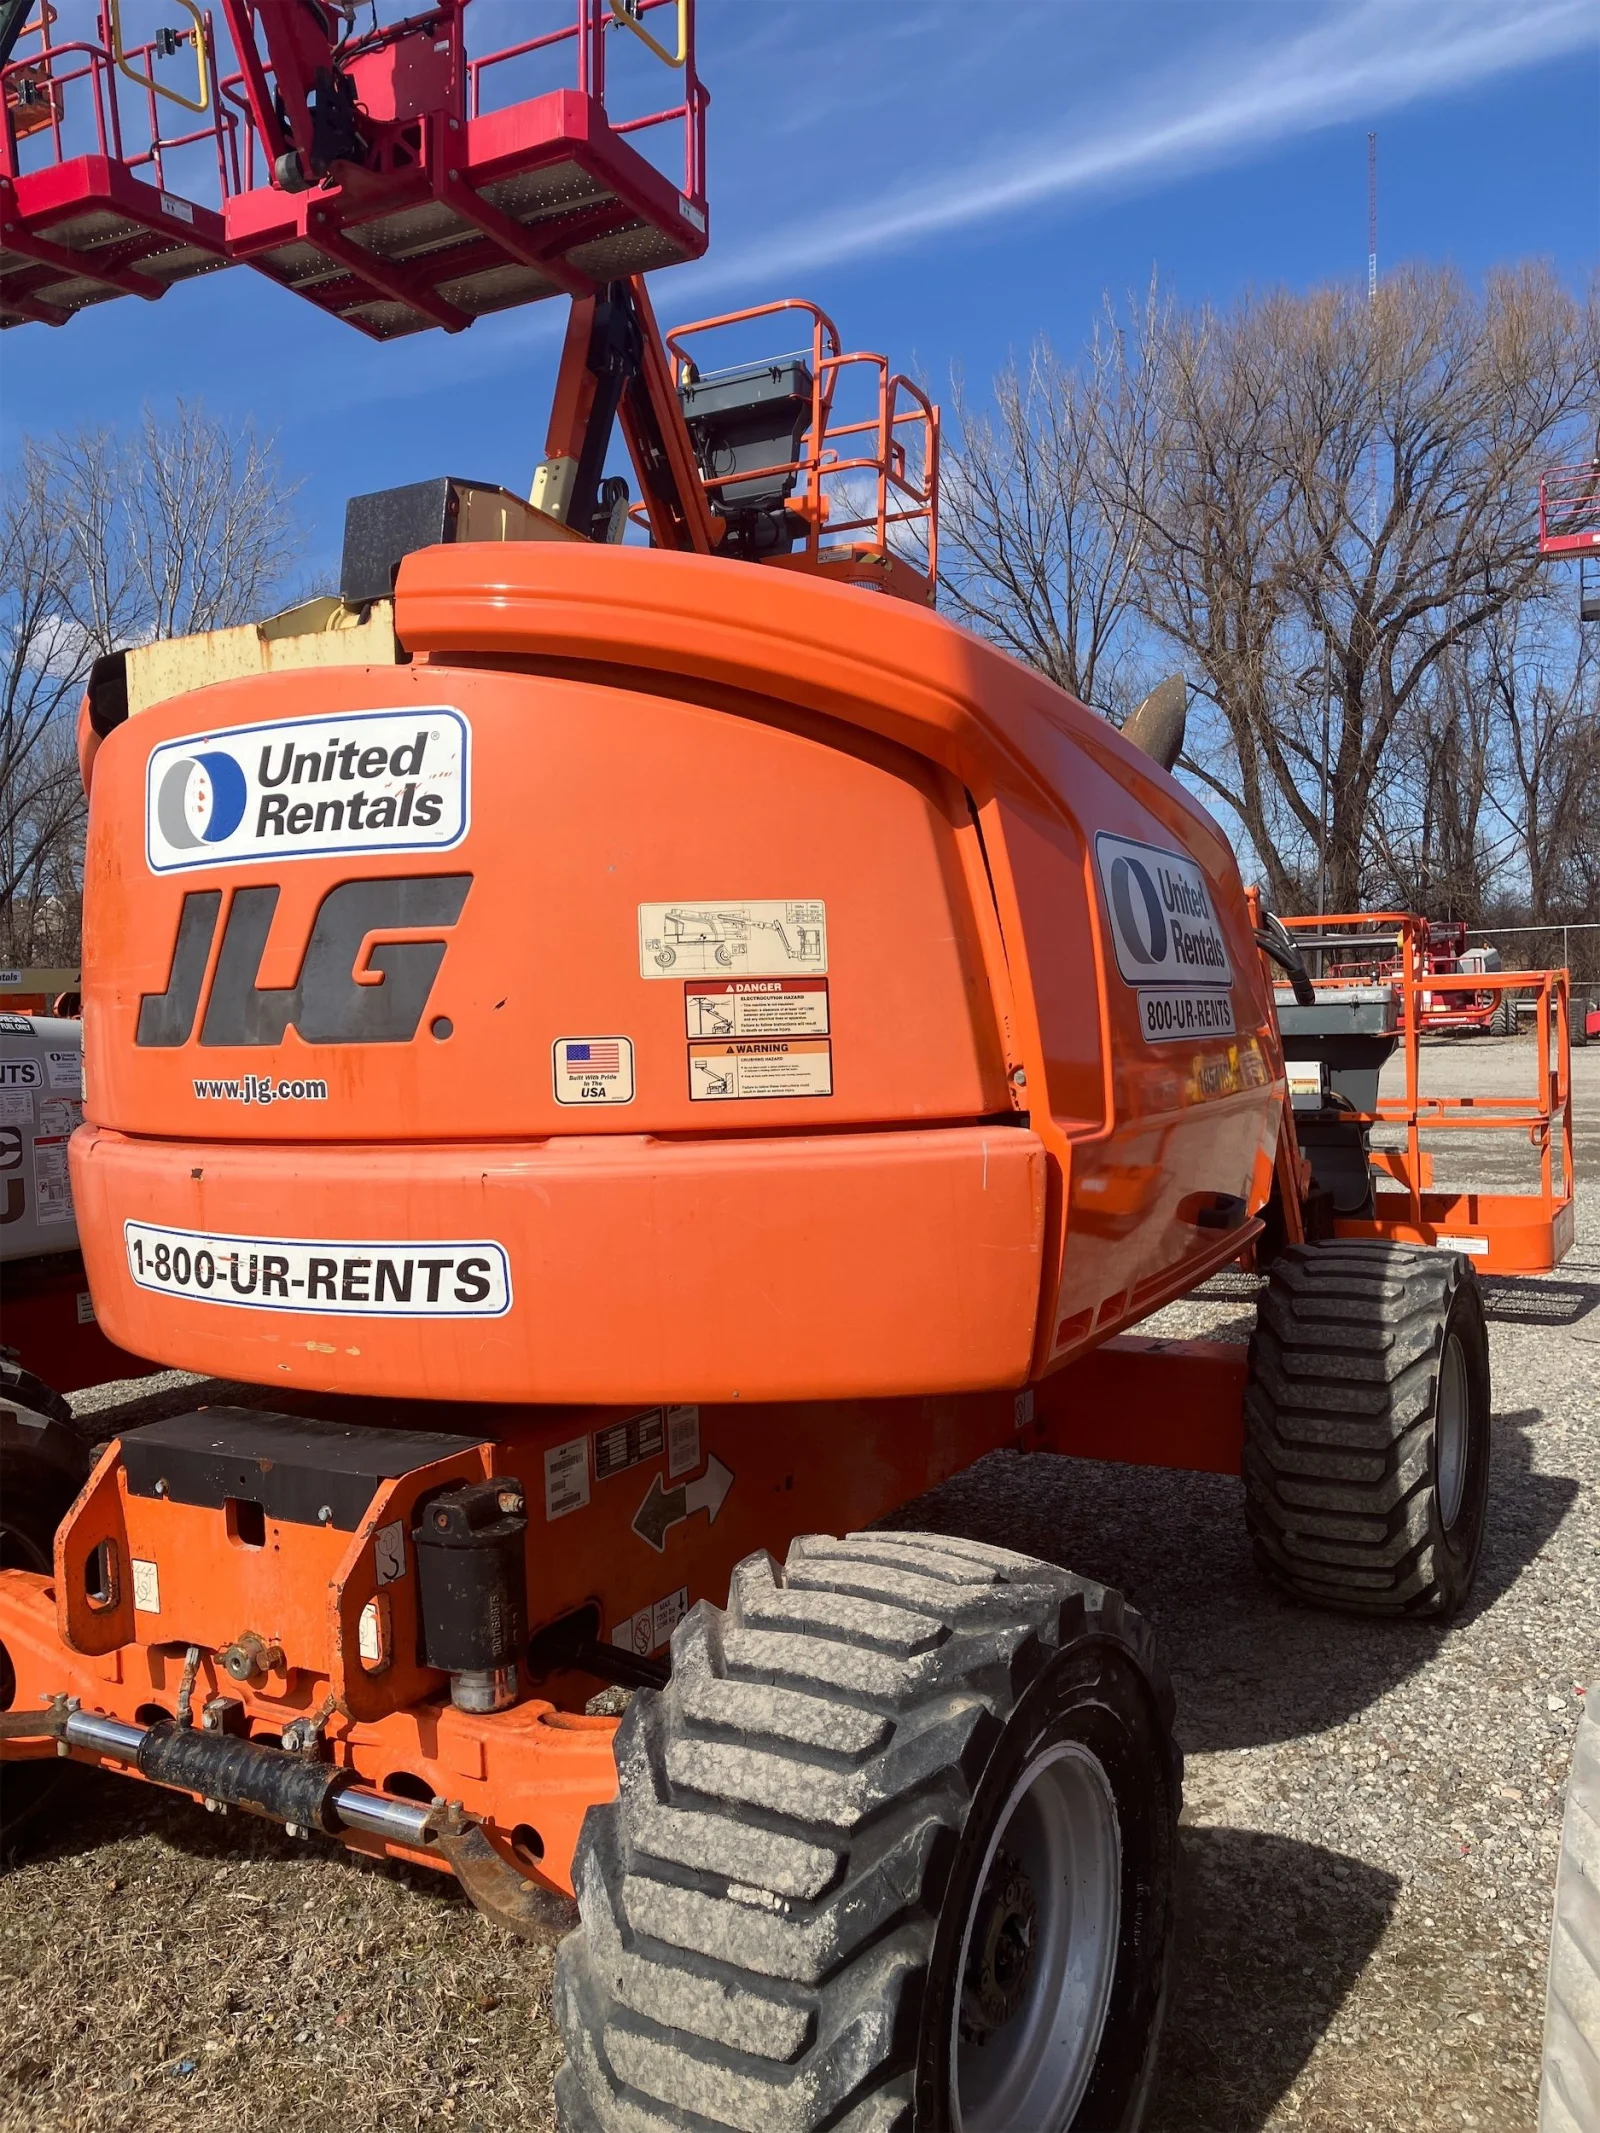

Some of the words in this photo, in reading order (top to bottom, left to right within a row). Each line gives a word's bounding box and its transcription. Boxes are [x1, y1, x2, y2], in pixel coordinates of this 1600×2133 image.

[258, 732, 429, 788] United
[256, 783, 444, 838] Rentals
[1157, 867, 1209, 920] United
[1170, 918, 1225, 968] Rentals
[736, 982, 782, 993] DANGER
[15, 1023, 31, 1031] ONLY
[1147, 999, 1231, 1031] 800-UR-RENTS
[736, 1043, 788, 1054] WARNING
[193, 1077, 328, 1104] www.jlg.com
[581, 1087, 606, 1098] USA
[134, 1239, 492, 1304] 1-800-UR-RENTS
